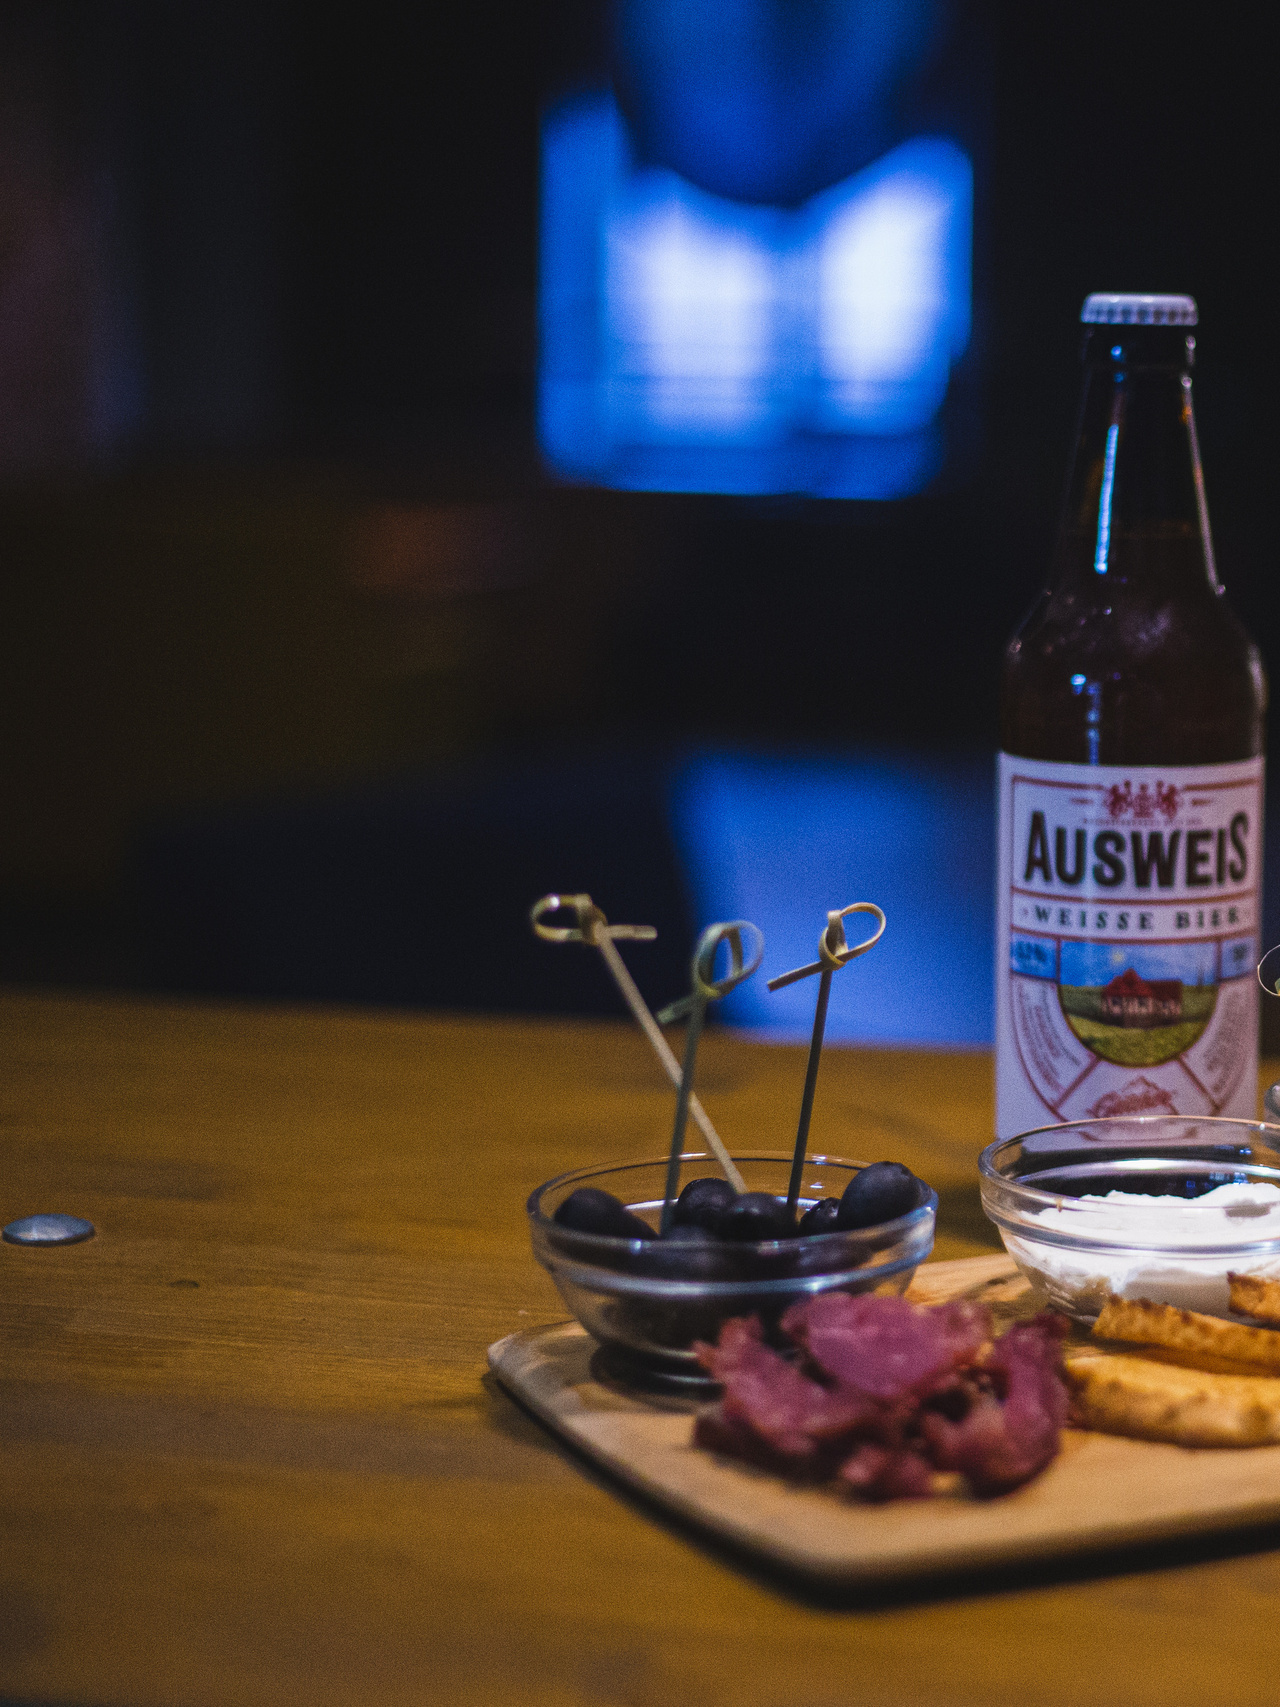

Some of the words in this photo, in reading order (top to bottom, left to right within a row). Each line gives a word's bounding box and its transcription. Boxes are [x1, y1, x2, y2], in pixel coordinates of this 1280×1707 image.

[1024, 810, 1249, 888] AUSWEIS
[1034, 905, 1154, 931] WEISSE
[1176, 906, 1240, 930] BIER
